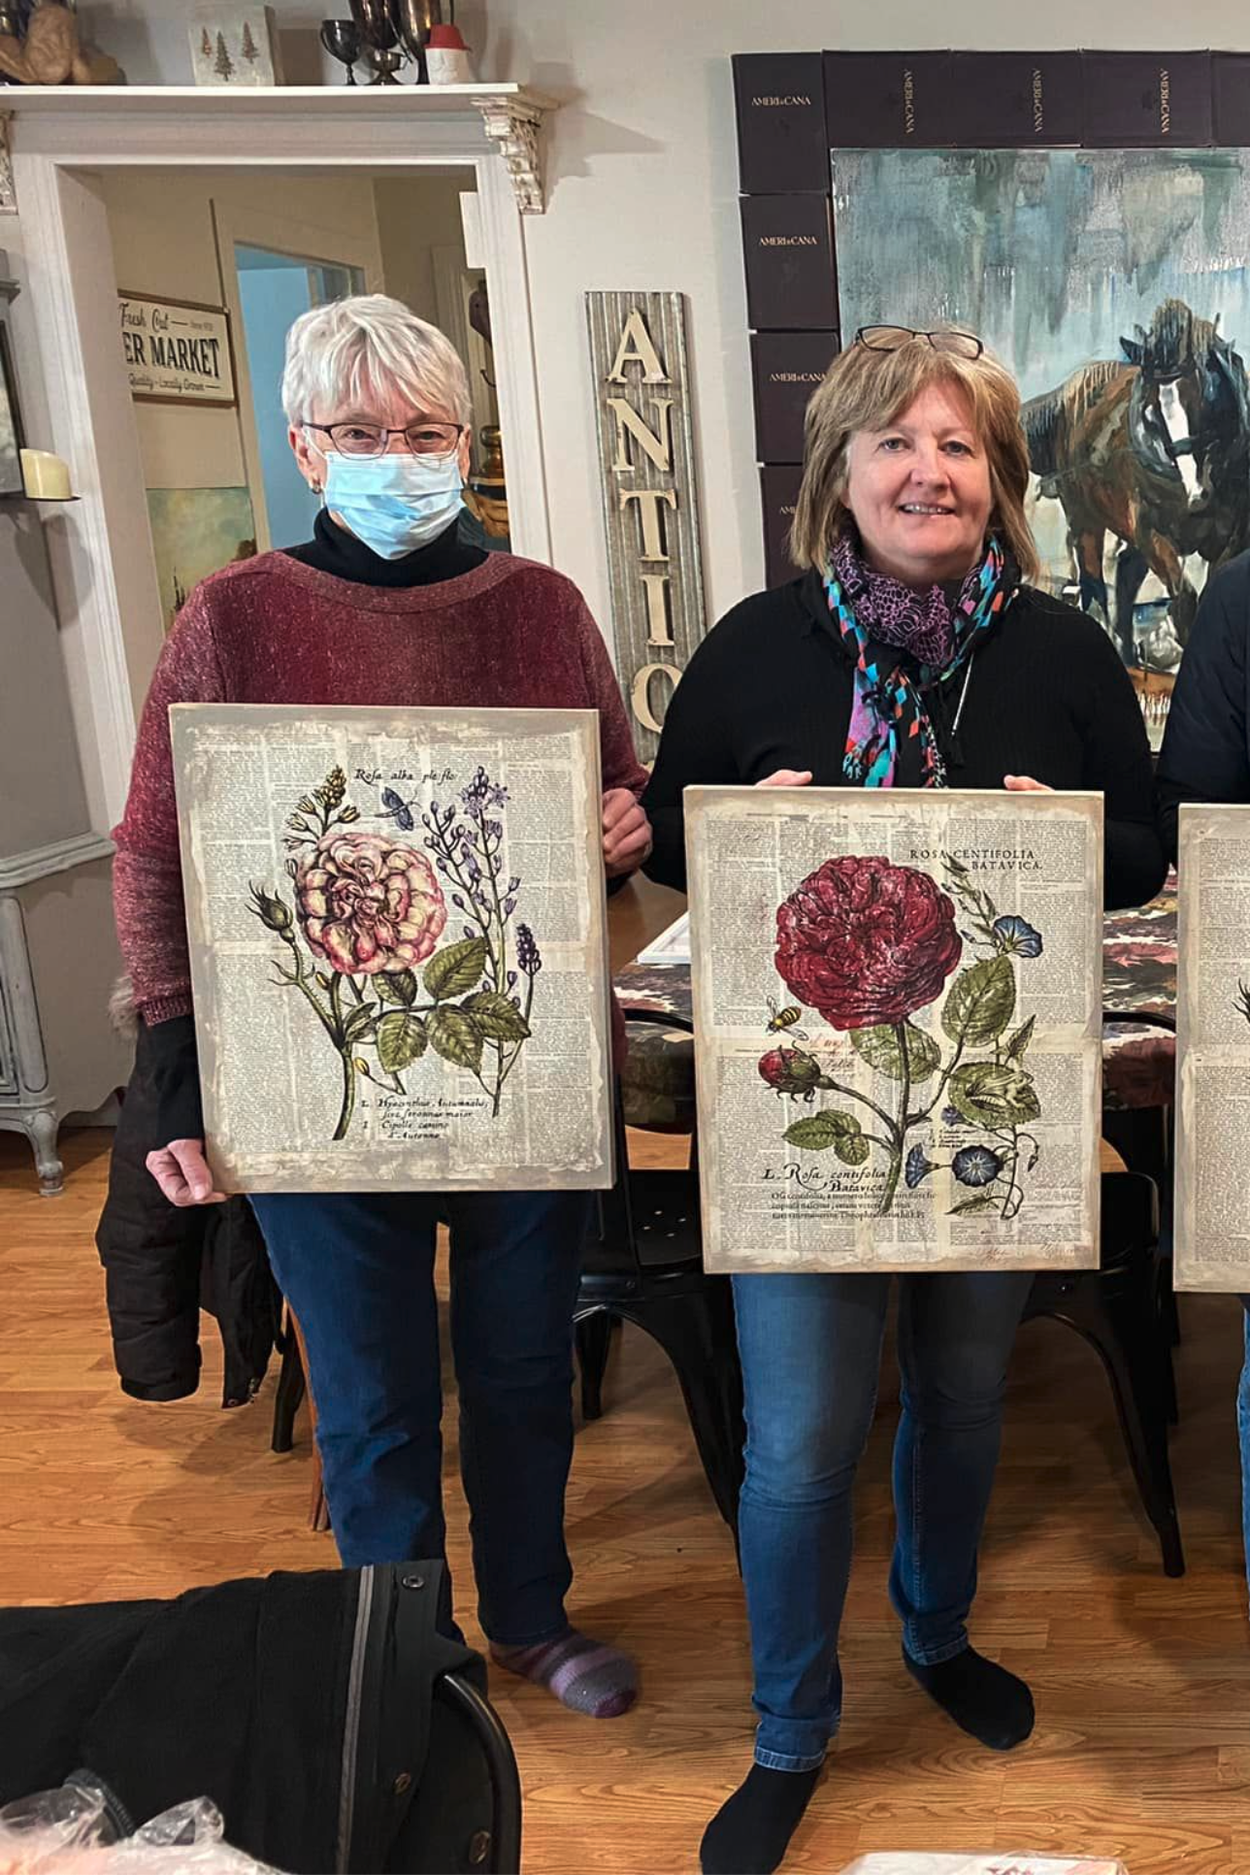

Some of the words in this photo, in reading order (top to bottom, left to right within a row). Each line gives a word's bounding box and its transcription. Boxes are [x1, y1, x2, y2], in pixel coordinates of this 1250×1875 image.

[148, 336, 220, 379] MARKET
[910, 849, 947, 859] ROSA
[953, 849, 1034, 859] CENTIFOLIA
[971, 861, 1043, 870] BATAVICA.
